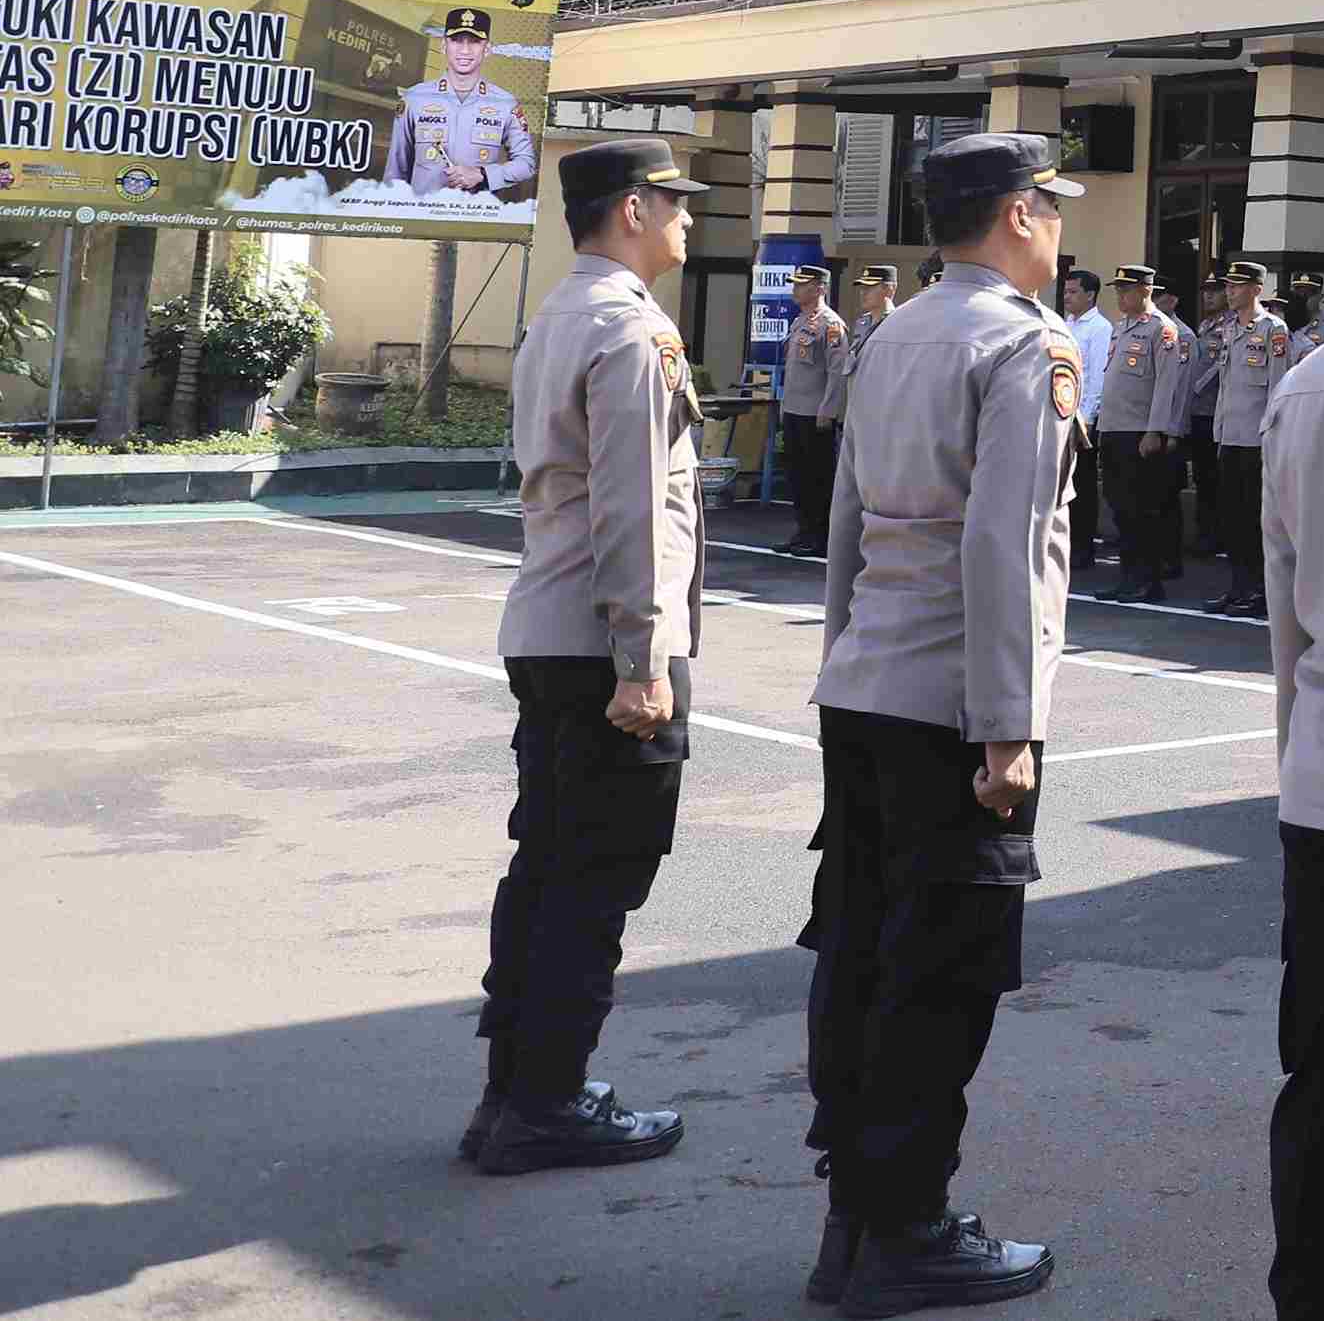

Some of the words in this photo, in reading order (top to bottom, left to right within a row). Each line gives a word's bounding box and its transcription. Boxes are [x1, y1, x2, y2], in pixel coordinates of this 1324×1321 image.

[0, 42, 56, 95] AS
[68, 49, 141, 103] (ZI)
[155, 56, 314, 116] MENUJU
[0, 97, 54, 151] RI
[65, 100, 238, 162] KORUPSI
[249, 115, 373, 172] (WBK)
[38, 207, 72, 219] Kota
[96, 209, 218, 227] @polreskedirikota
[236, 215, 403, 235] @humas_polres_kedirikota
